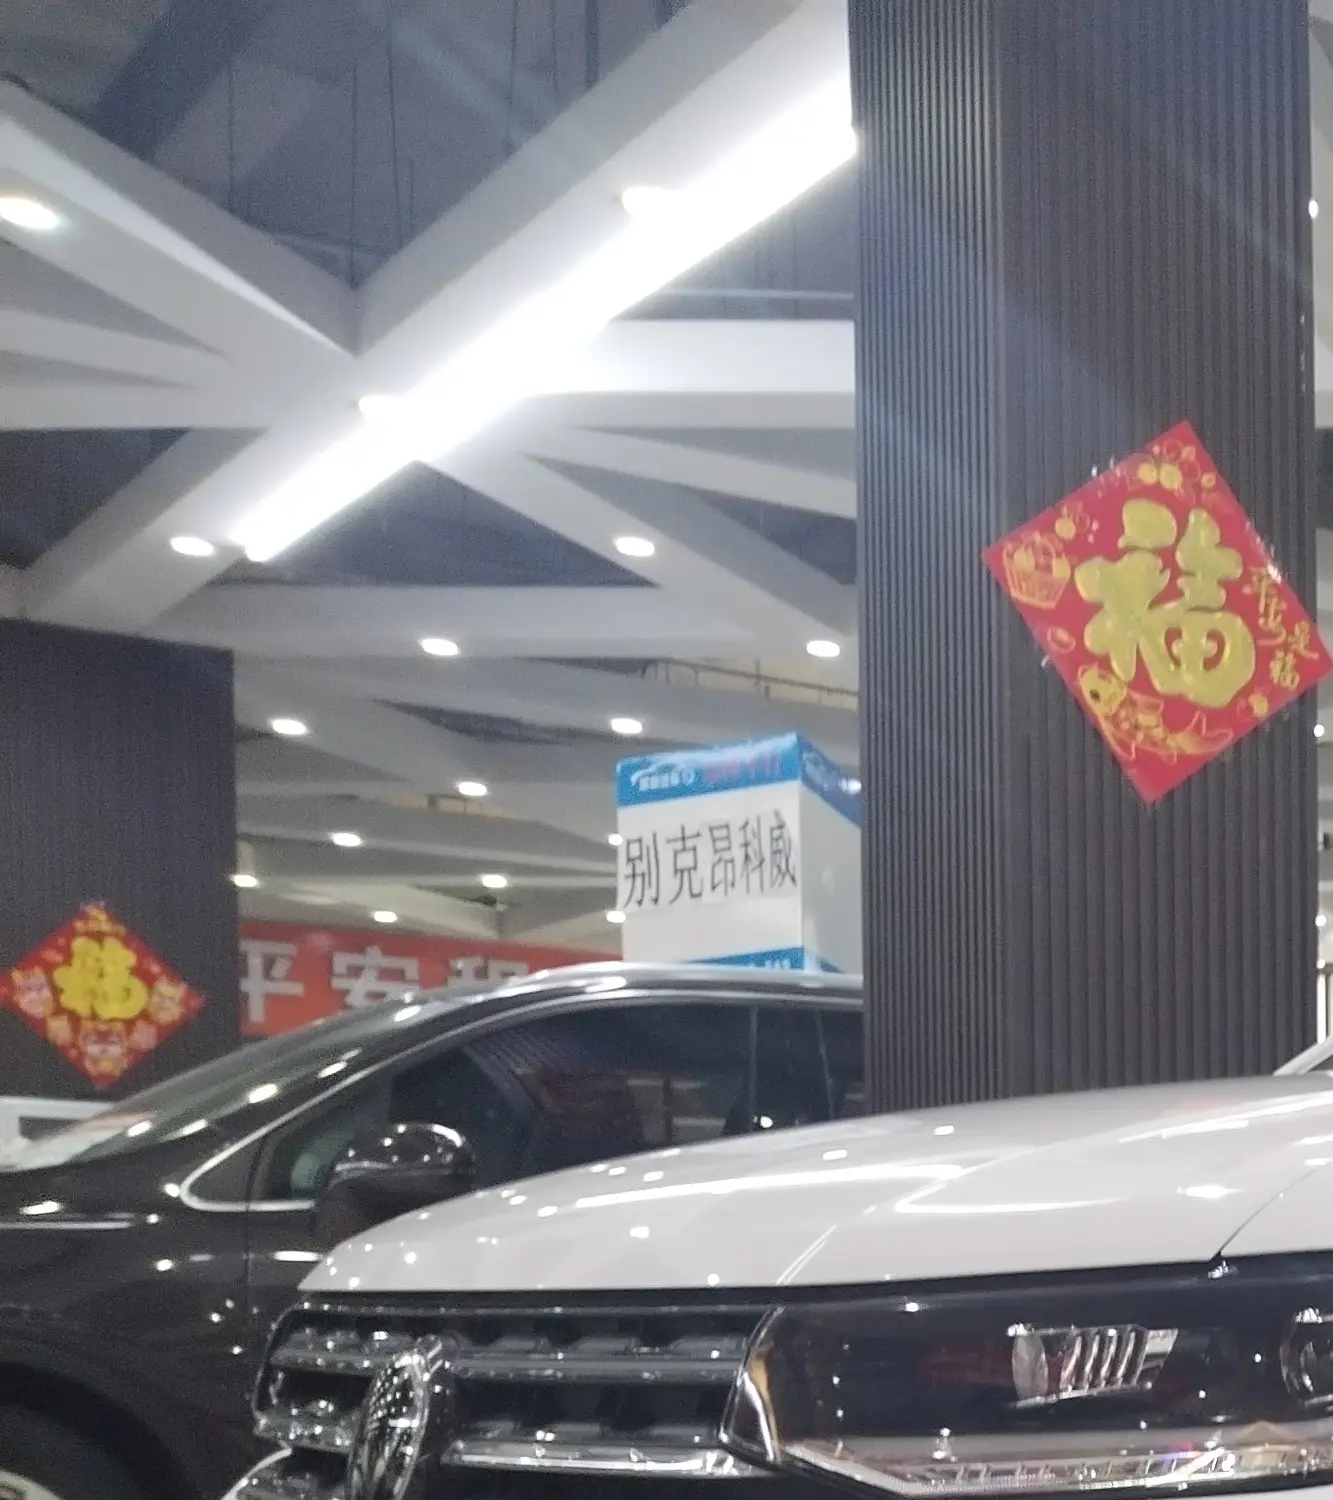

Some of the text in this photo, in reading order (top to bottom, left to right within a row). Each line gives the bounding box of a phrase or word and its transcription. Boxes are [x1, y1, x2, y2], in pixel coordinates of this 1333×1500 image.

[1074, 497, 1256, 710] 福
[624, 808, 798, 909] 别克昂科威
